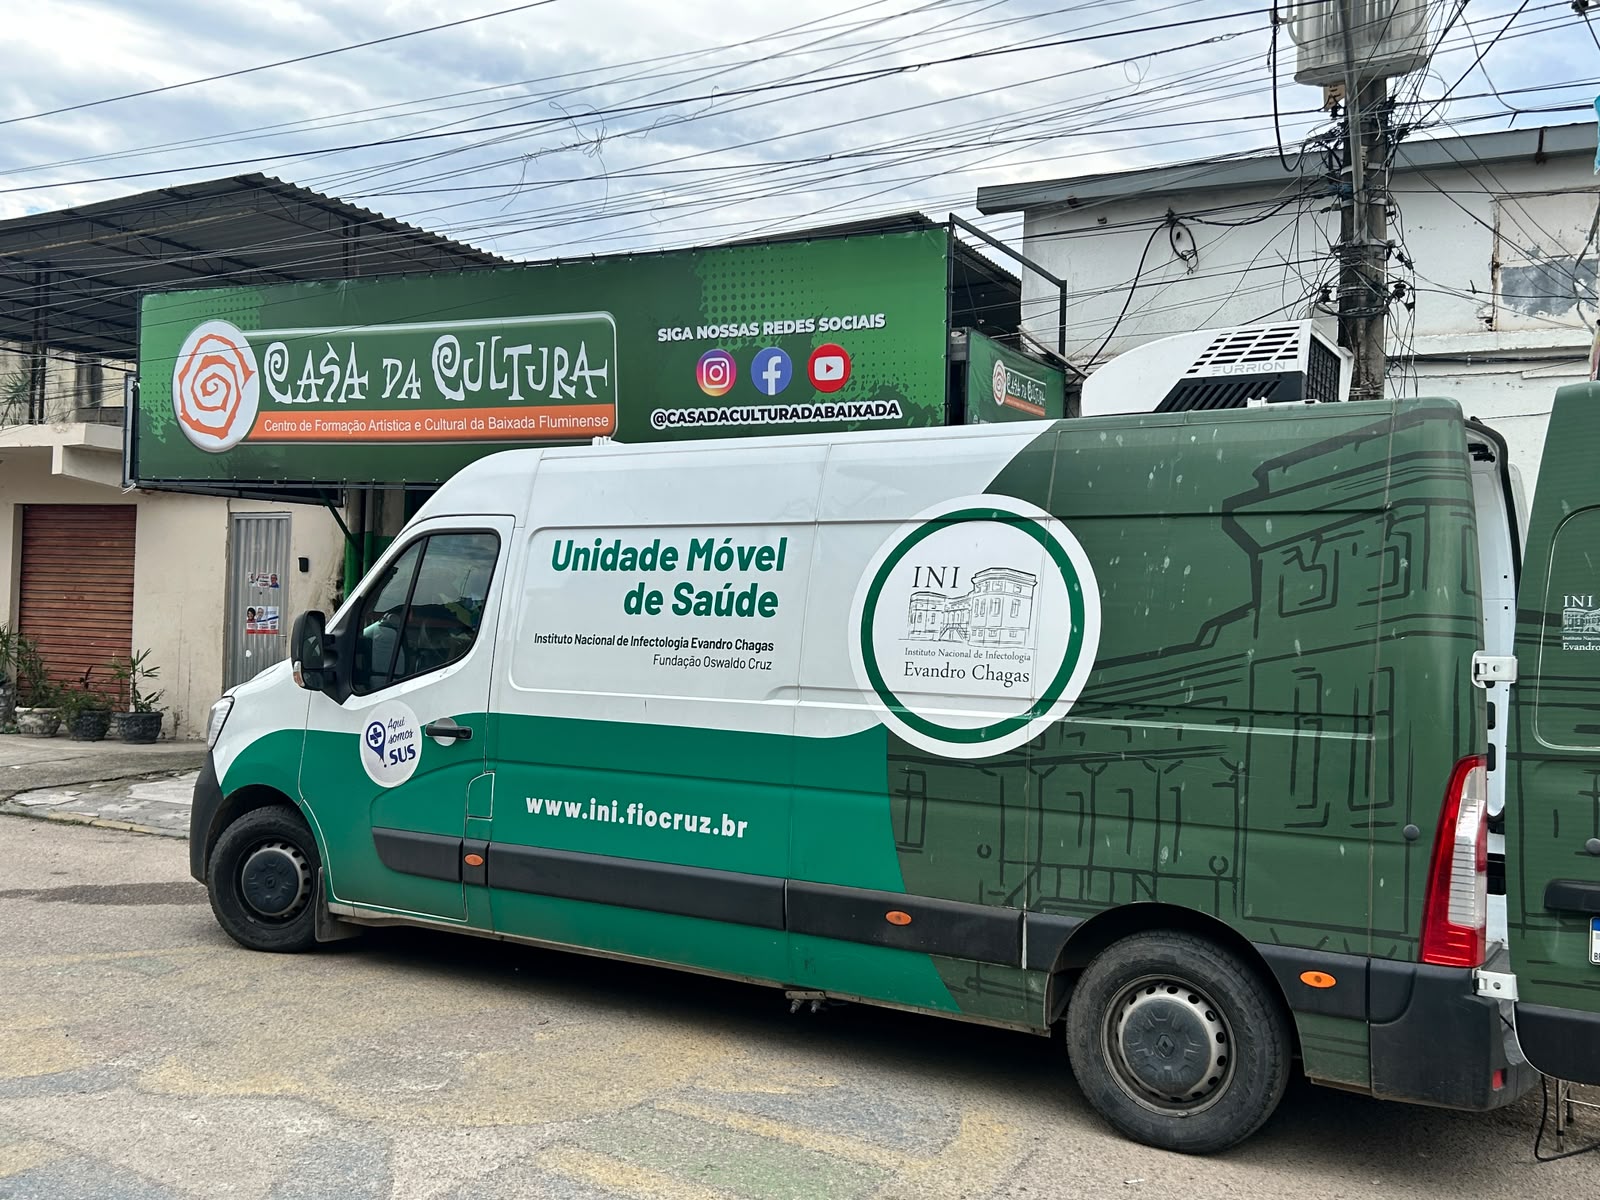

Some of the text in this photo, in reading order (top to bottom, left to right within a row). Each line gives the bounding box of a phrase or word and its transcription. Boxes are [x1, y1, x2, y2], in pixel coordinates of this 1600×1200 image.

[657, 313, 886, 342] SIGA NOSSAS REDES SOCIAIS
[263, 334, 608, 404] CASA DA CULTURA
[1212, 361, 1286, 376] FURRION
[264, 415, 609, 434] Centro de Formação Artística e Cultural da Baixada Fluminense
[651, 401, 902, 429] @CASADACULTURADABAIXADA
[551, 536, 788, 572] Unidade Móvel
[912, 565, 960, 589] INI
[623, 582, 779, 618] de Saúde
[1563, 595, 1593, 608] INI
[534, 633, 774, 654] Instituto Nacional de Infectologia Evandro Chagas
[904, 647, 1031, 663] Instituto Nacional de Infectologia
[653, 654, 772, 671] Fundação Oswaldo Cruz
[904, 661, 1030, 688] Evandro Chagas
[388, 716, 405, 732] Aqui
[388, 728, 414, 745] somos
[389, 743, 416, 766] SUS
[525, 797, 748, 838] www.ini.fiocruz.br
